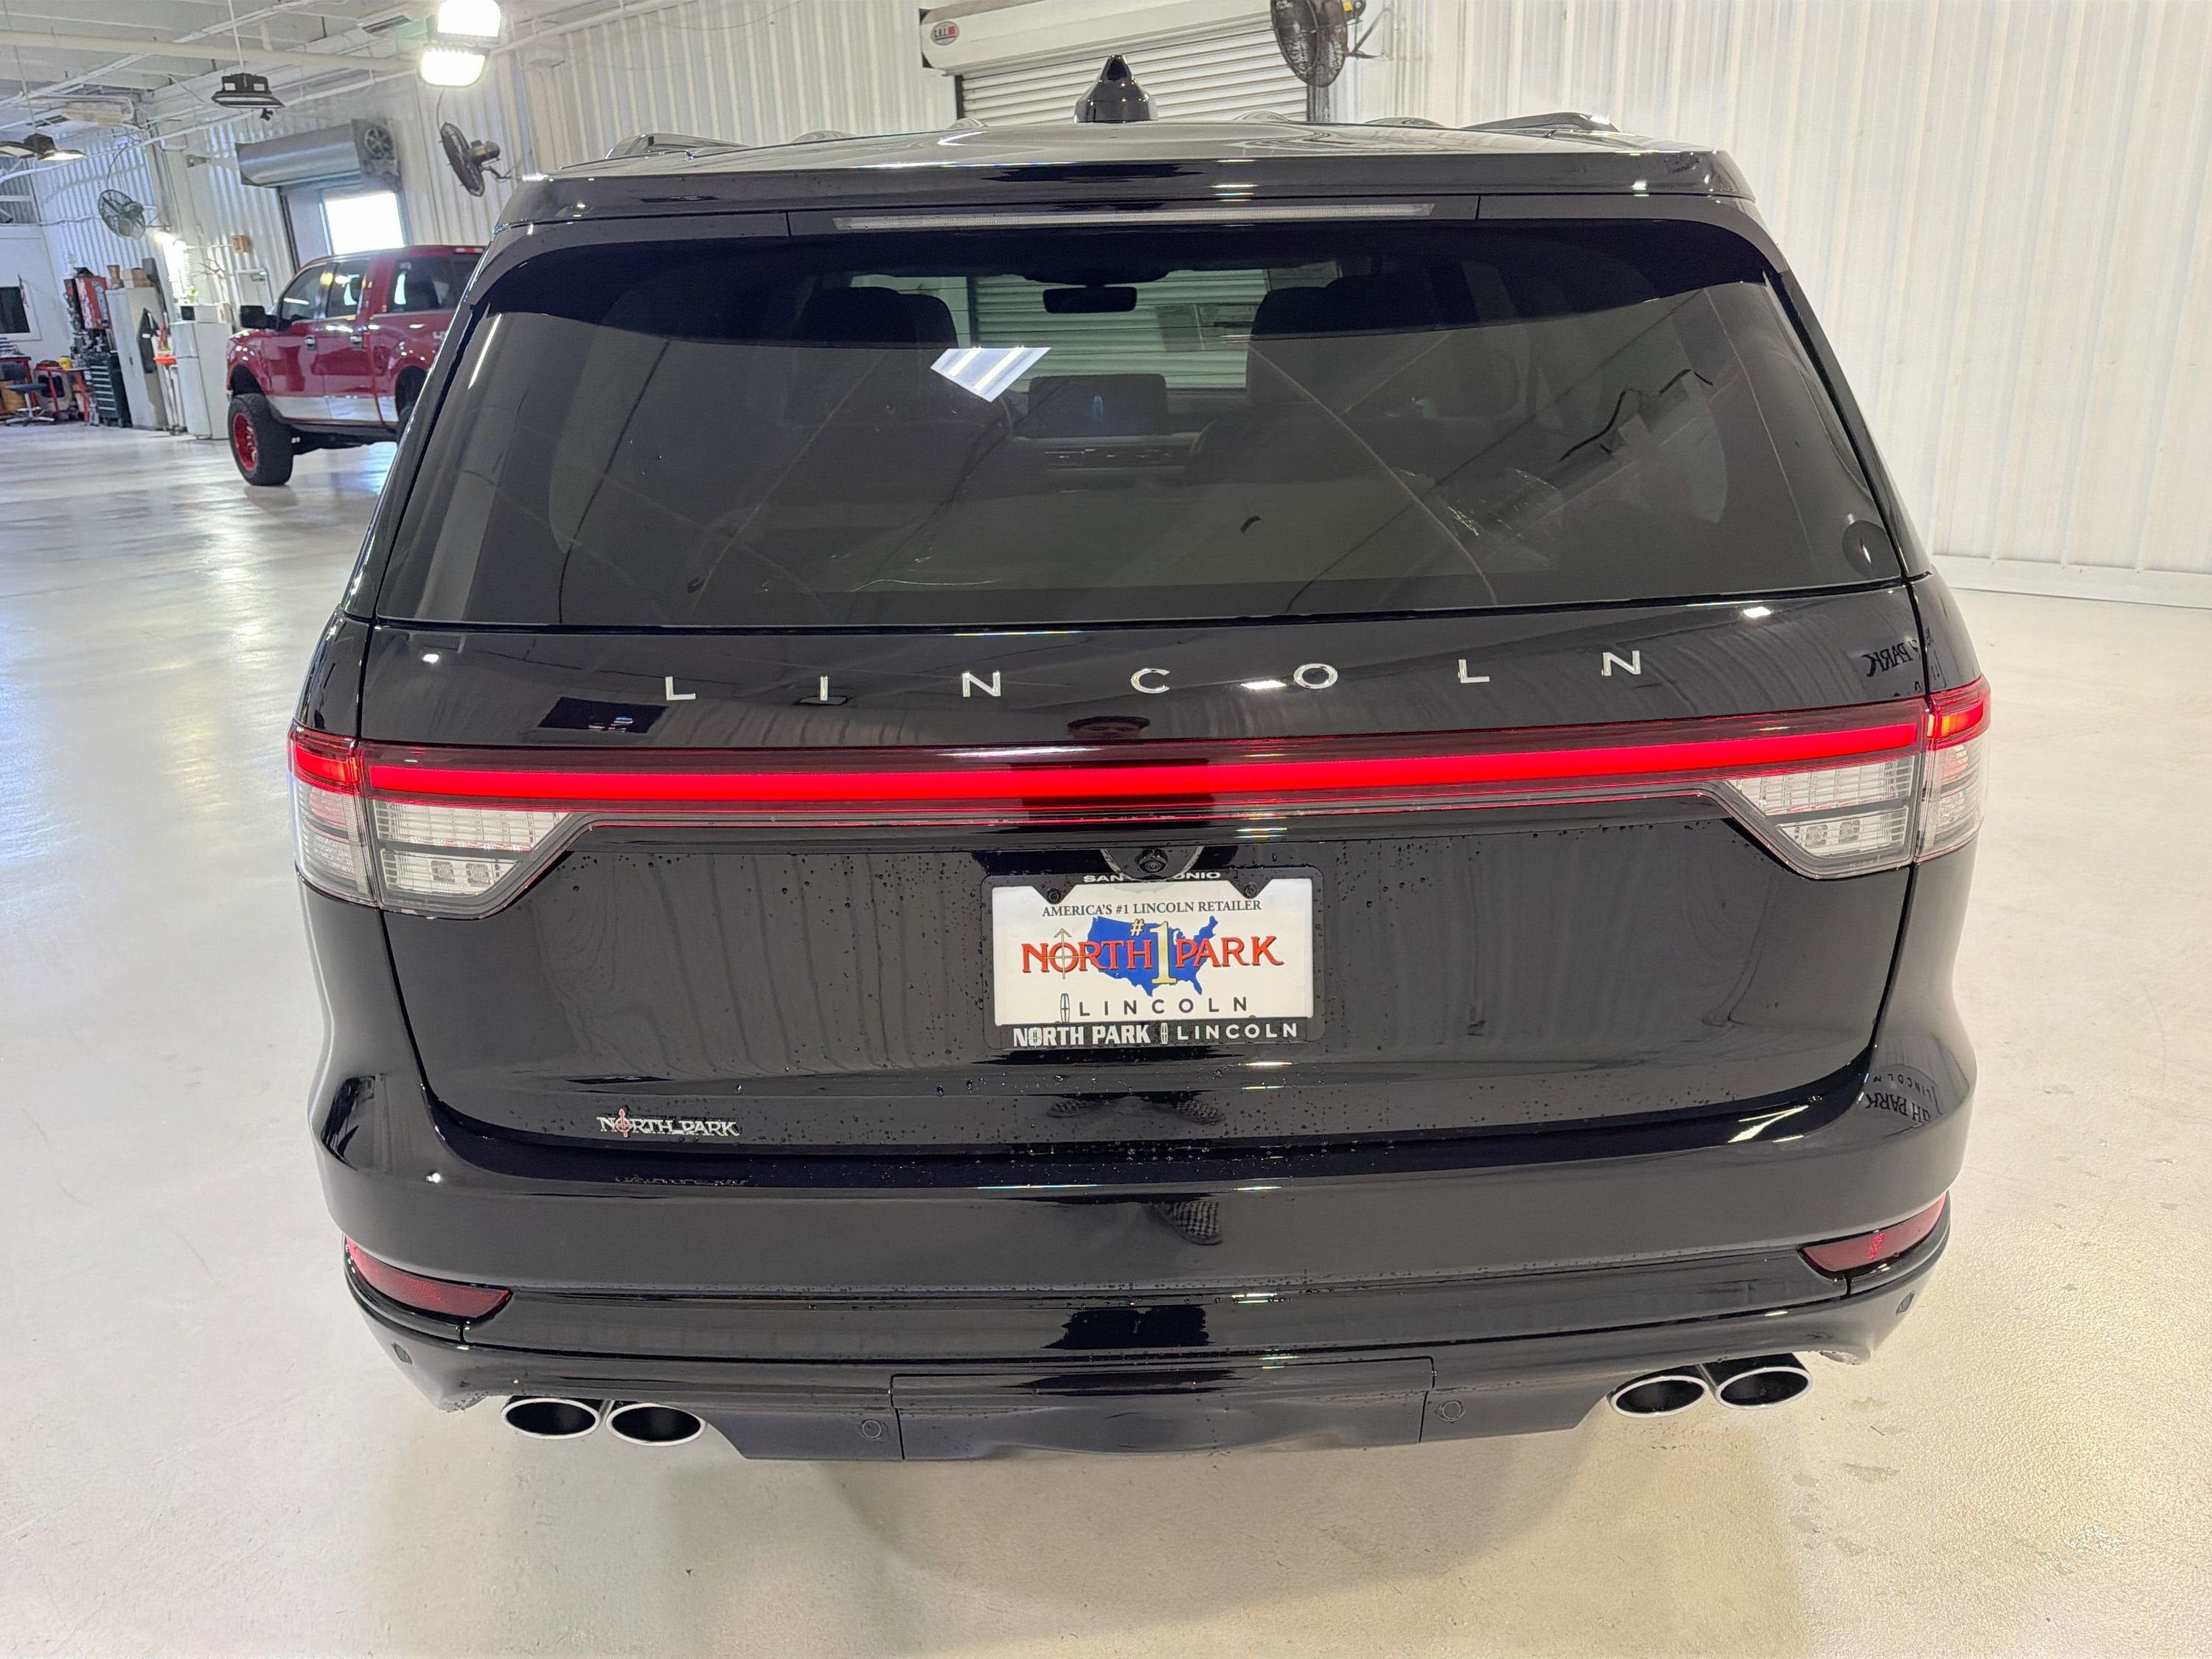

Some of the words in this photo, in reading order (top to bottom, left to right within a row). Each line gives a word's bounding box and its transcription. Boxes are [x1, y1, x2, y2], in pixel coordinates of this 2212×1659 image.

[665, 650, 1641, 700] LINCOLN
[1042, 905, 1113, 917] AMERICA’S
[1116, 903, 1130, 915] #1
[1133, 901, 1195, 914] LINCOLN
[1197, 900, 1262, 912] RETAILER
[1021, 939, 1152, 973] NORTH
[1175, 936, 1285, 968] PARK
[1079, 996, 1248, 1017] LINCOLN
[1013, 1026, 1088, 1047] NORTH
[1092, 1025, 1151, 1045] PARK
[1177, 1023, 1298, 1040] LINCOLN
[597, 1116, 673, 1135] NORTH
[678, 1119, 741, 1136] PARK
